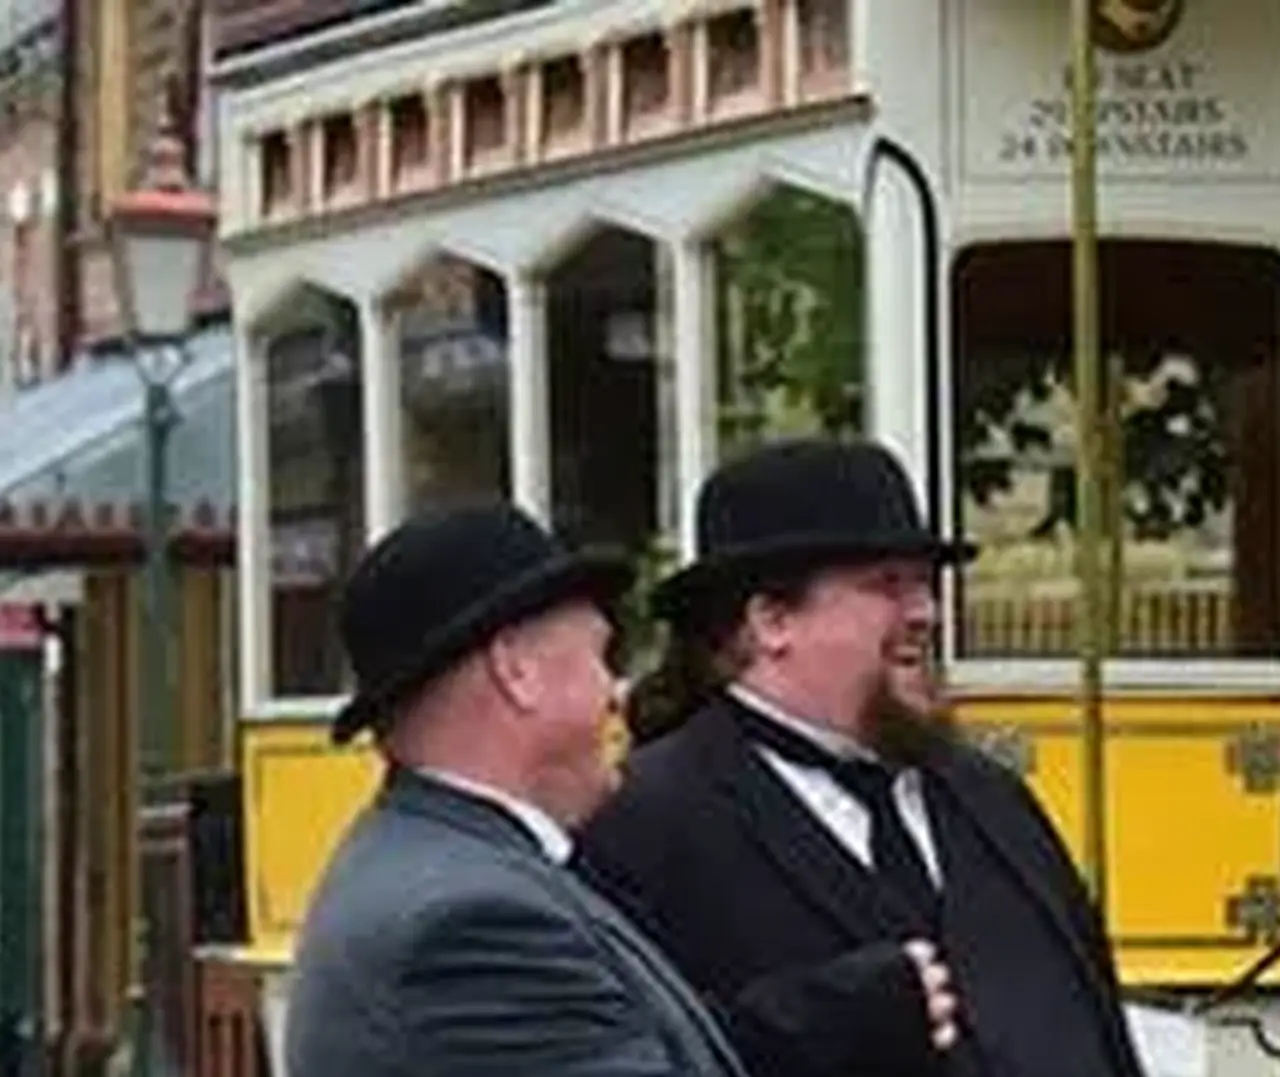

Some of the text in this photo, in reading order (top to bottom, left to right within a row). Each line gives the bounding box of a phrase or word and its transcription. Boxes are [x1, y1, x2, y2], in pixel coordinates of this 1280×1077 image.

[1113, 63, 1202, 90] SEAT
[1093, 98, 1226, 126] PSTAIRS
[998, 132, 1250, 161] 24 DNSTAIRS
